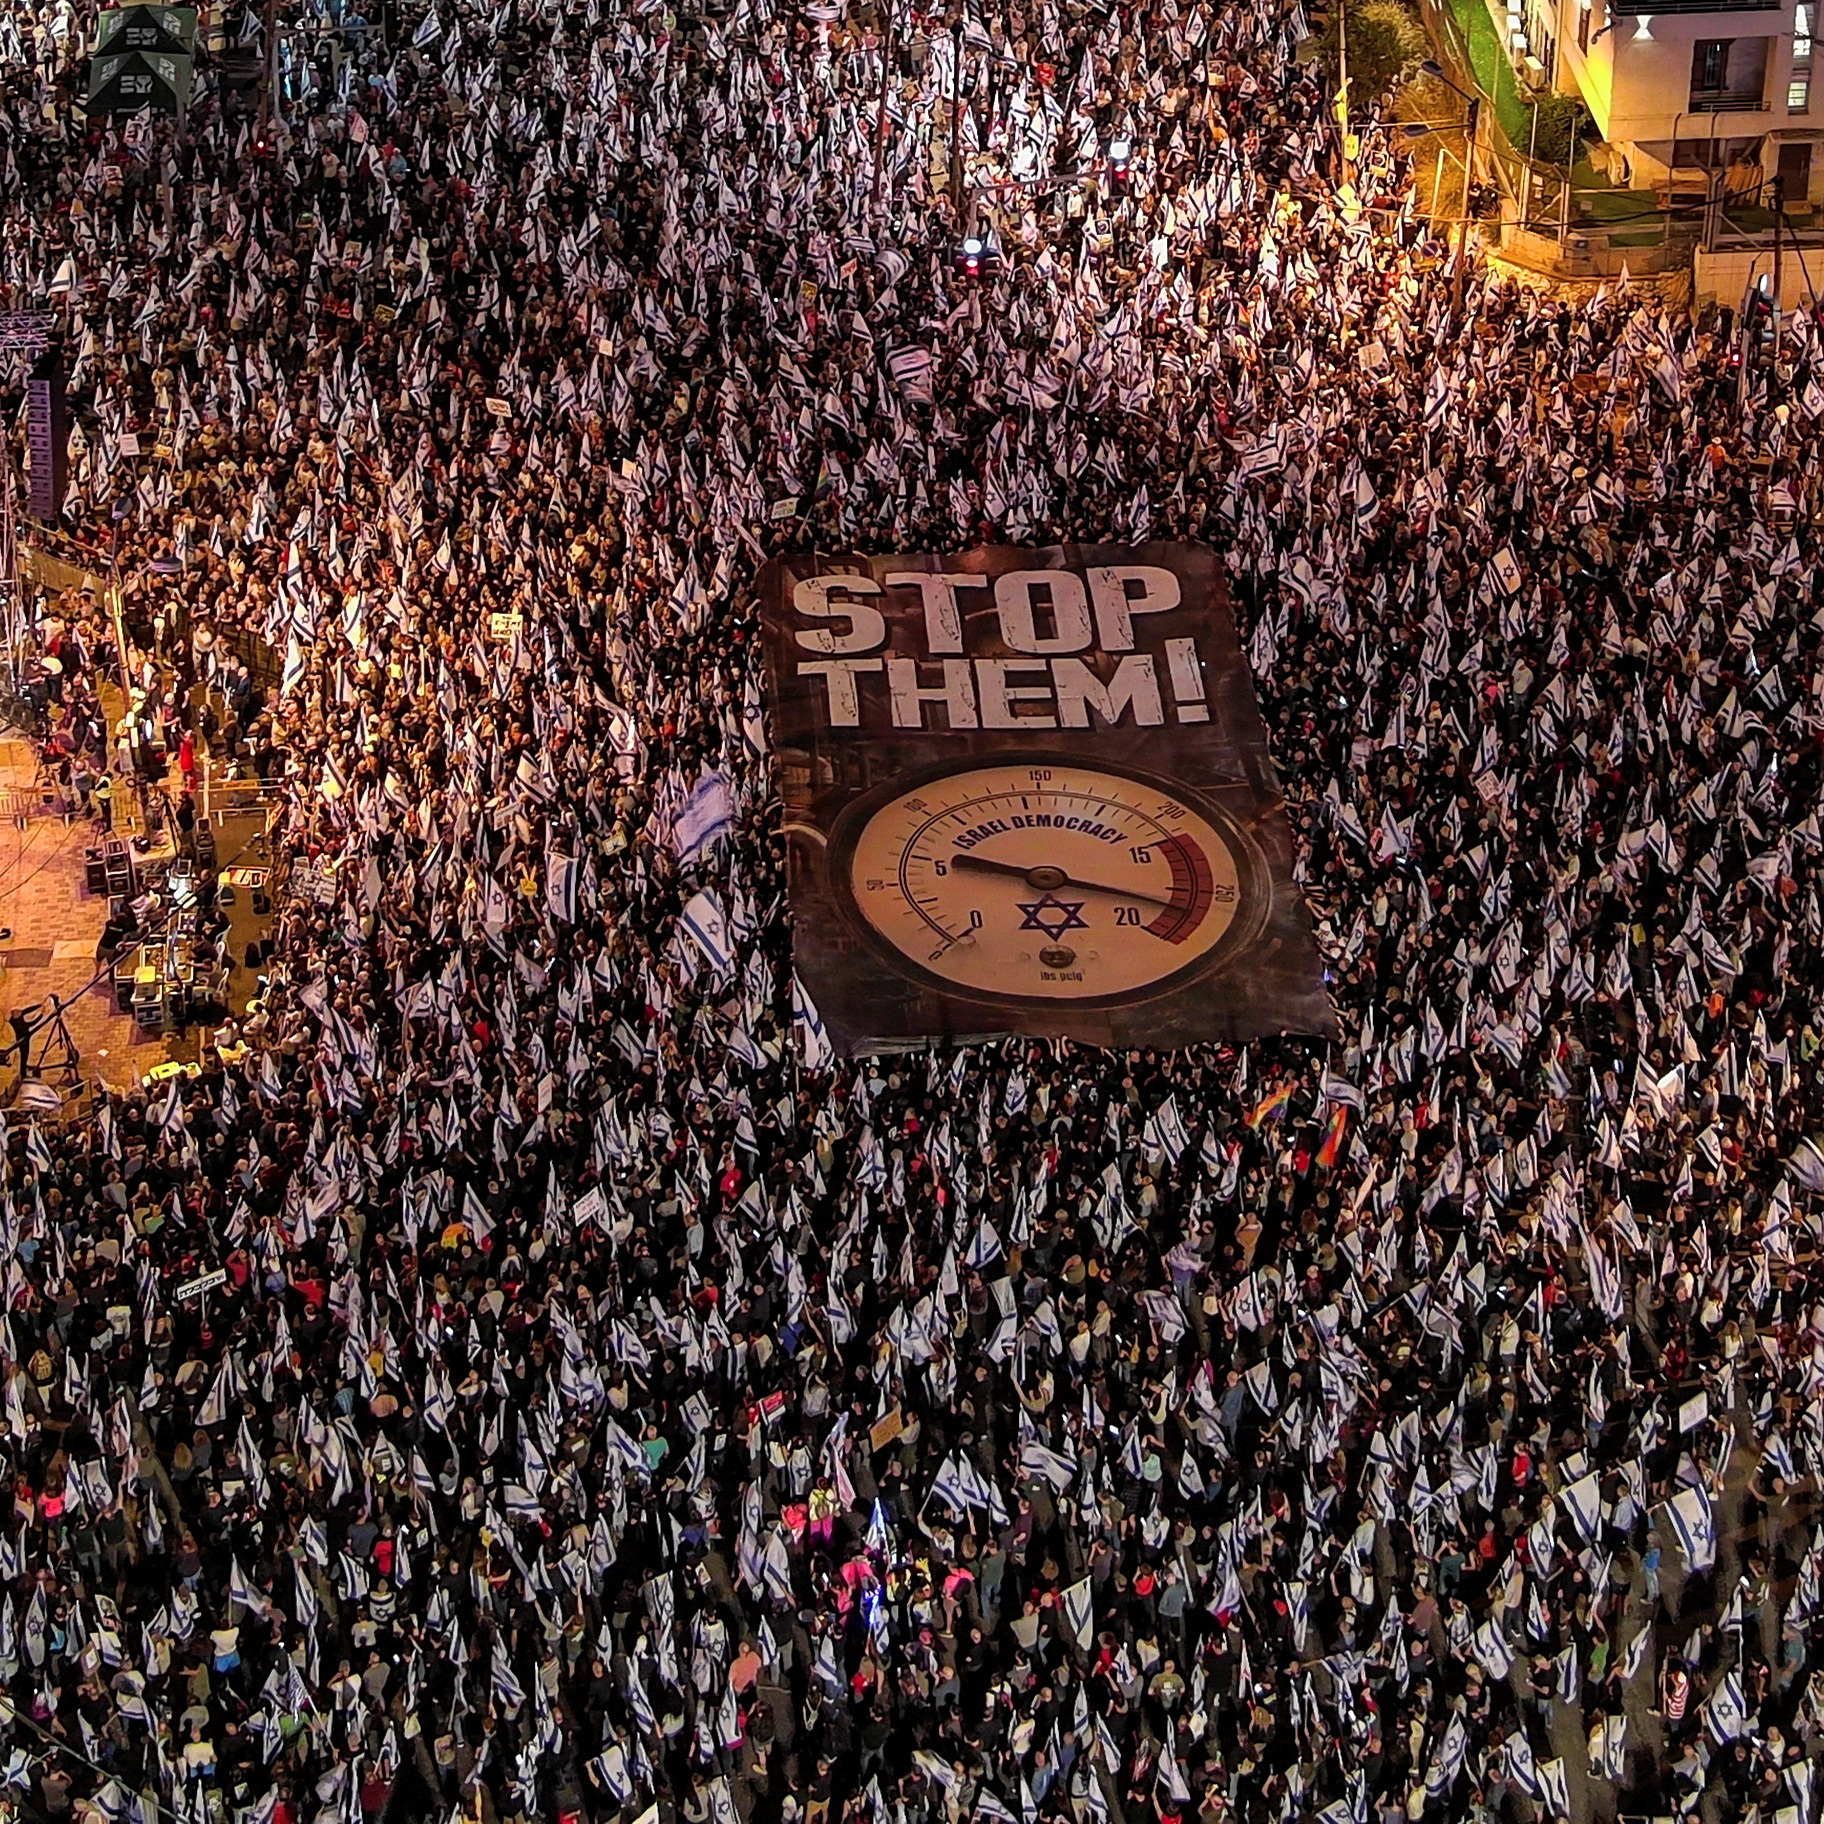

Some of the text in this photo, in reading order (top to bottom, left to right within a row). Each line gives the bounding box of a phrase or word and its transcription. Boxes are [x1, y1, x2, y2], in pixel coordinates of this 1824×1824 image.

[791, 565, 1182, 655] STOP
[796, 637, 1211, 730] THEM!
[1029, 770, 1052, 782] 150
[902, 797, 928, 813] 100
[1157, 801, 1187, 820] 200
[952, 814, 1129, 850] ISRAEL DEMOCRACY
[1129, 846, 1153, 865] 15
[935, 860, 947, 876] 5
[1215, 885, 1235, 903] 250
[970, 910, 982, 928] 0
[1113, 907, 1141, 926] 20
